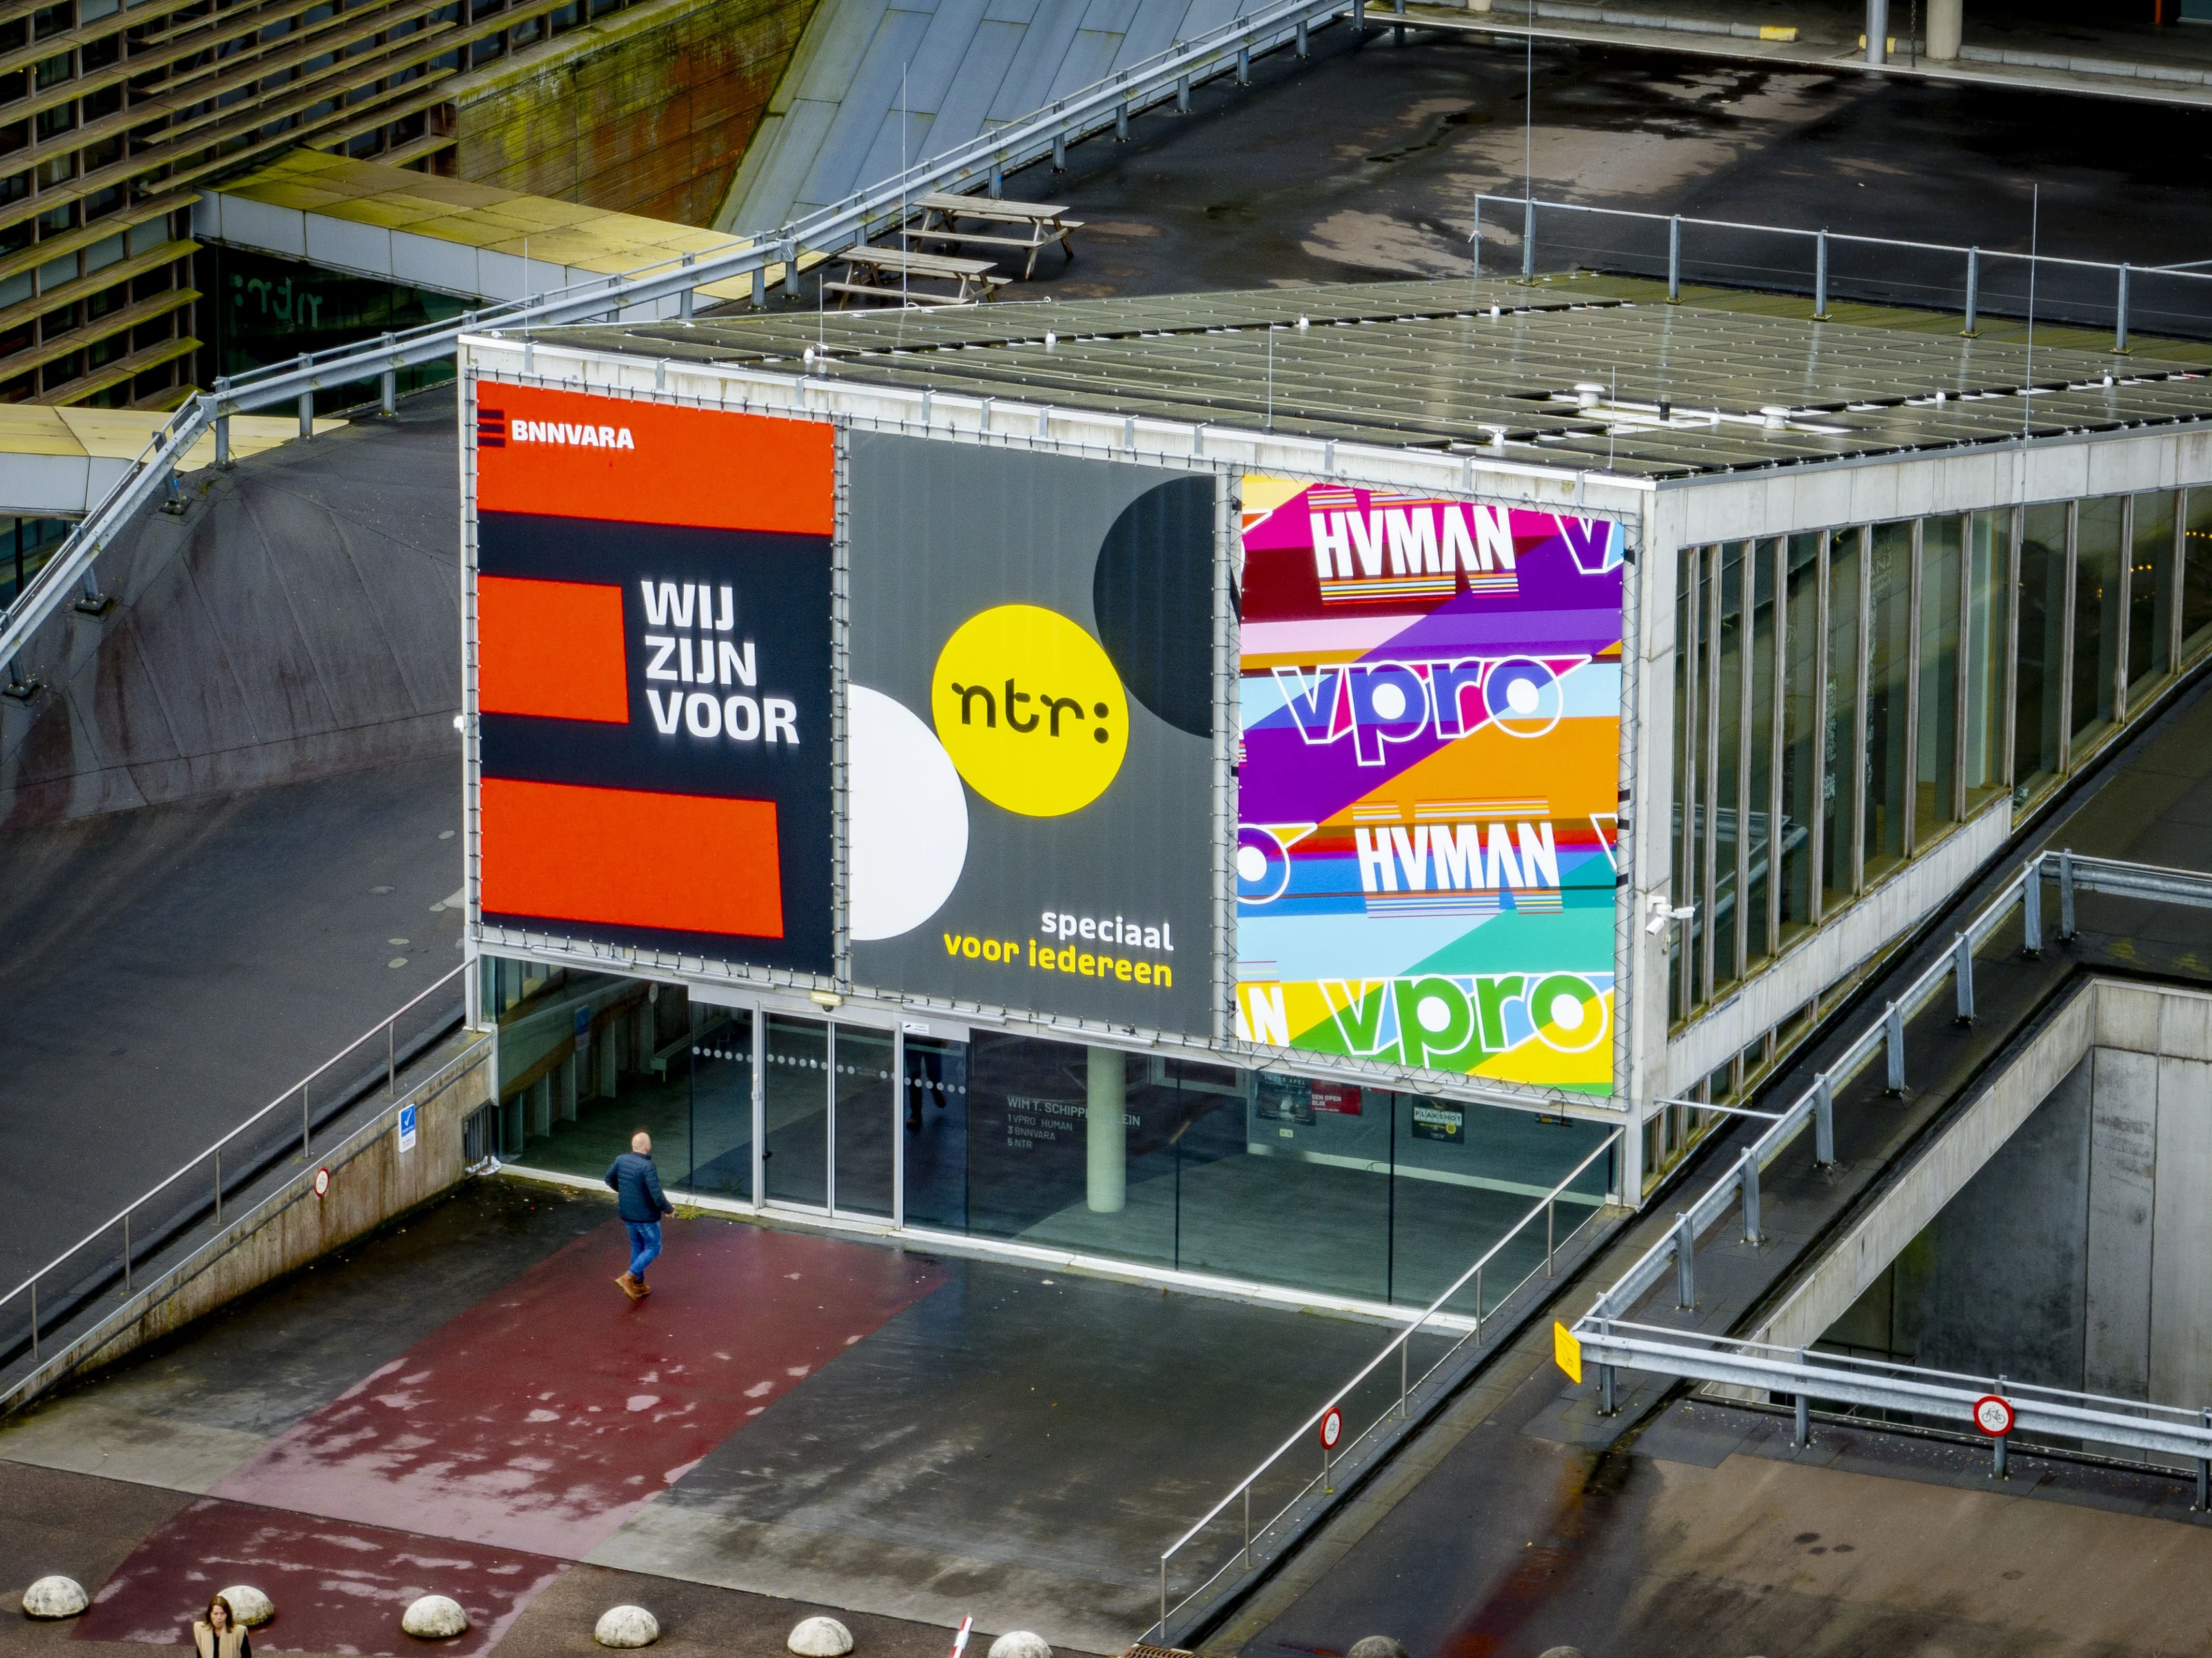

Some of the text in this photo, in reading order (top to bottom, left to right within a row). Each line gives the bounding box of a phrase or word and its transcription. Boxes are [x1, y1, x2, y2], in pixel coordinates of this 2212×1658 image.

[511, 419, 635, 450] BNNVARA
[641, 580, 734, 631] WIJ
[645, 635, 757, 687] ZIJN
[646, 689, 800, 744] VOOR
[951, 677, 1109, 744] ntr:
[1271, 654, 1592, 766] vpro
[1041, 911, 1174, 951] speciaal
[944, 933, 1173, 987] voor iedereen
[1316, 970, 1611, 1069] vpro
[1007, 1096, 1030, 1110] WIM
[1032, 1101, 1042, 1112] T.
[1013, 1114, 1036, 1126] VPRO
[1041, 1118, 1073, 1131] HUMAN
[1008, 1126, 1056, 1141] 3 BNNVARA
[1008, 1138, 1032, 1149] 5 NTR
